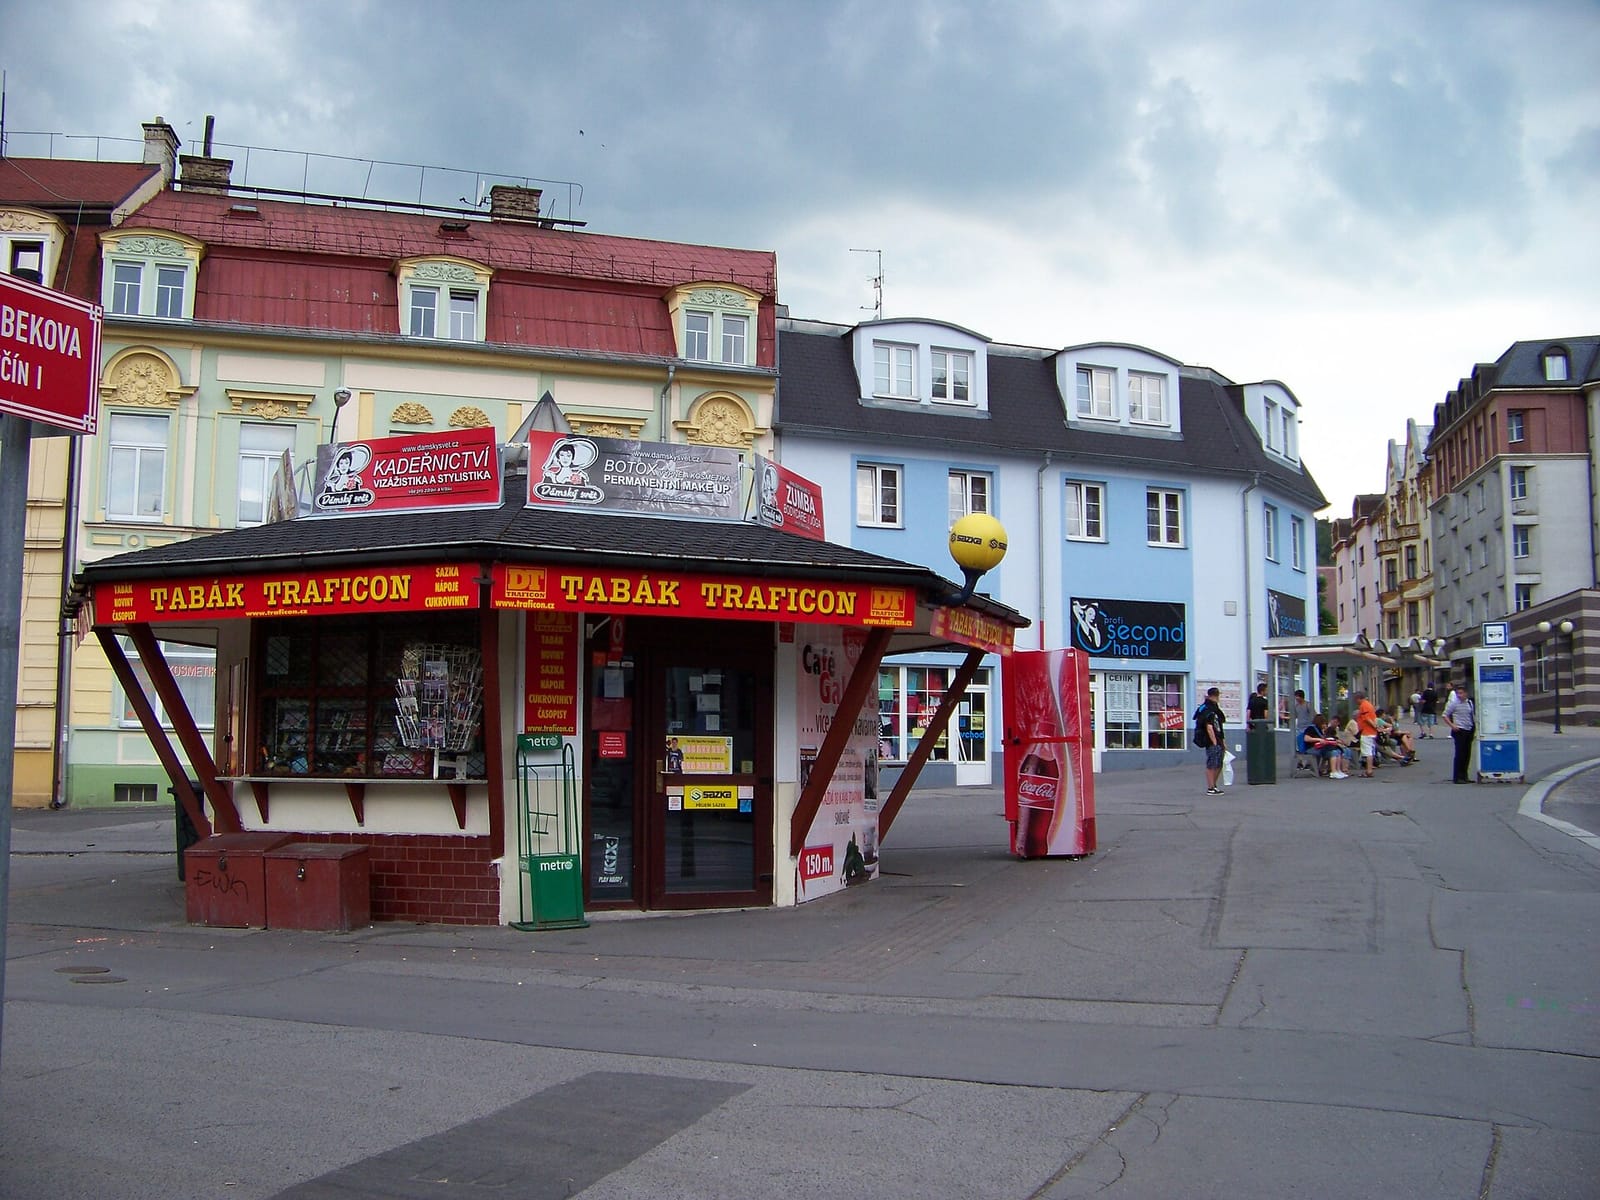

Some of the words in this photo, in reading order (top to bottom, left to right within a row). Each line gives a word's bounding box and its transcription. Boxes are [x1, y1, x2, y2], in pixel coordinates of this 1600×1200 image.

[1, 305, 82, 359] BEKOVA
[373, 445, 490, 477] KADEŘNICTVÍ
[604, 460, 658, 476] BOTOX
[373, 475, 428, 489] VIZÁŽISTIKA
[438, 470, 491, 484] STYLISTIKA
[603, 475, 681, 491] PERMANENTNÍ
[683, 481, 713, 492] MAKE
[715, 483, 731, 494] UP
[786, 485, 816, 516] ZUMBA
[435, 567, 459, 577] SAZKA
[507, 569, 545, 590] DT
[151, 580, 245, 611] TABÁK
[264, 575, 411, 606] TRAFICON
[434, 580, 459, 592] NÁPOJE
[560, 574, 680, 606] TABÁK
[701, 582, 857, 615] TRAFICON
[424, 595, 469, 607] CUKROVINKY
[495, 599, 555, 609] www.traficon.cz
[112, 610, 136, 621] ČASOPISY
[1104, 616, 1124, 625] profi
[1107, 622, 1184, 643] second
[1113, 640, 1149, 657] hand
[528, 694, 574, 705] CUKROVINKY
[537, 706, 567, 719] ČASOPISY
[1020, 780, 1055, 798] Coca-Cola
[540, 860, 573, 872] metro
[806, 854, 820, 875] 150
[821, 856, 833, 872] m.
